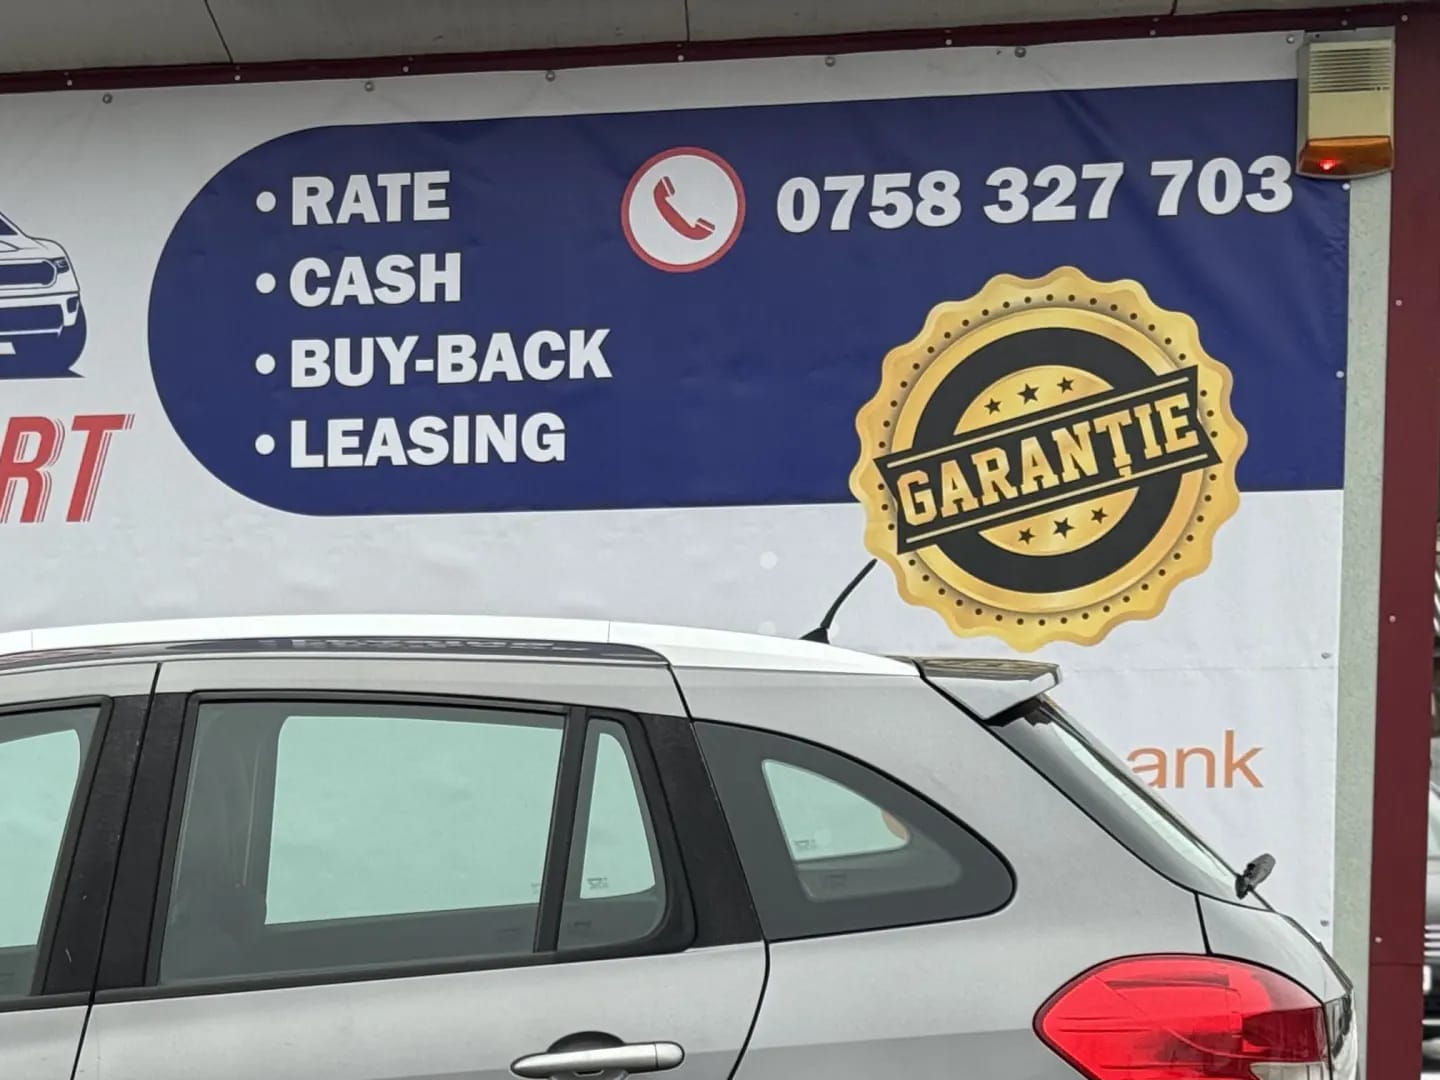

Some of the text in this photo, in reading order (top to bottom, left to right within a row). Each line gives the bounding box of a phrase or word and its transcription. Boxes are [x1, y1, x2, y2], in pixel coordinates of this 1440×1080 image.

[291, 170, 451, 226] RATE
[776, 155, 1293, 233] 0758 327 703
[289, 252, 461, 308] CASH
[291, 328, 613, 388] BUY-BACK
[290, 412, 566, 468] LEASING
[1126, 729, 1264, 789] ank
